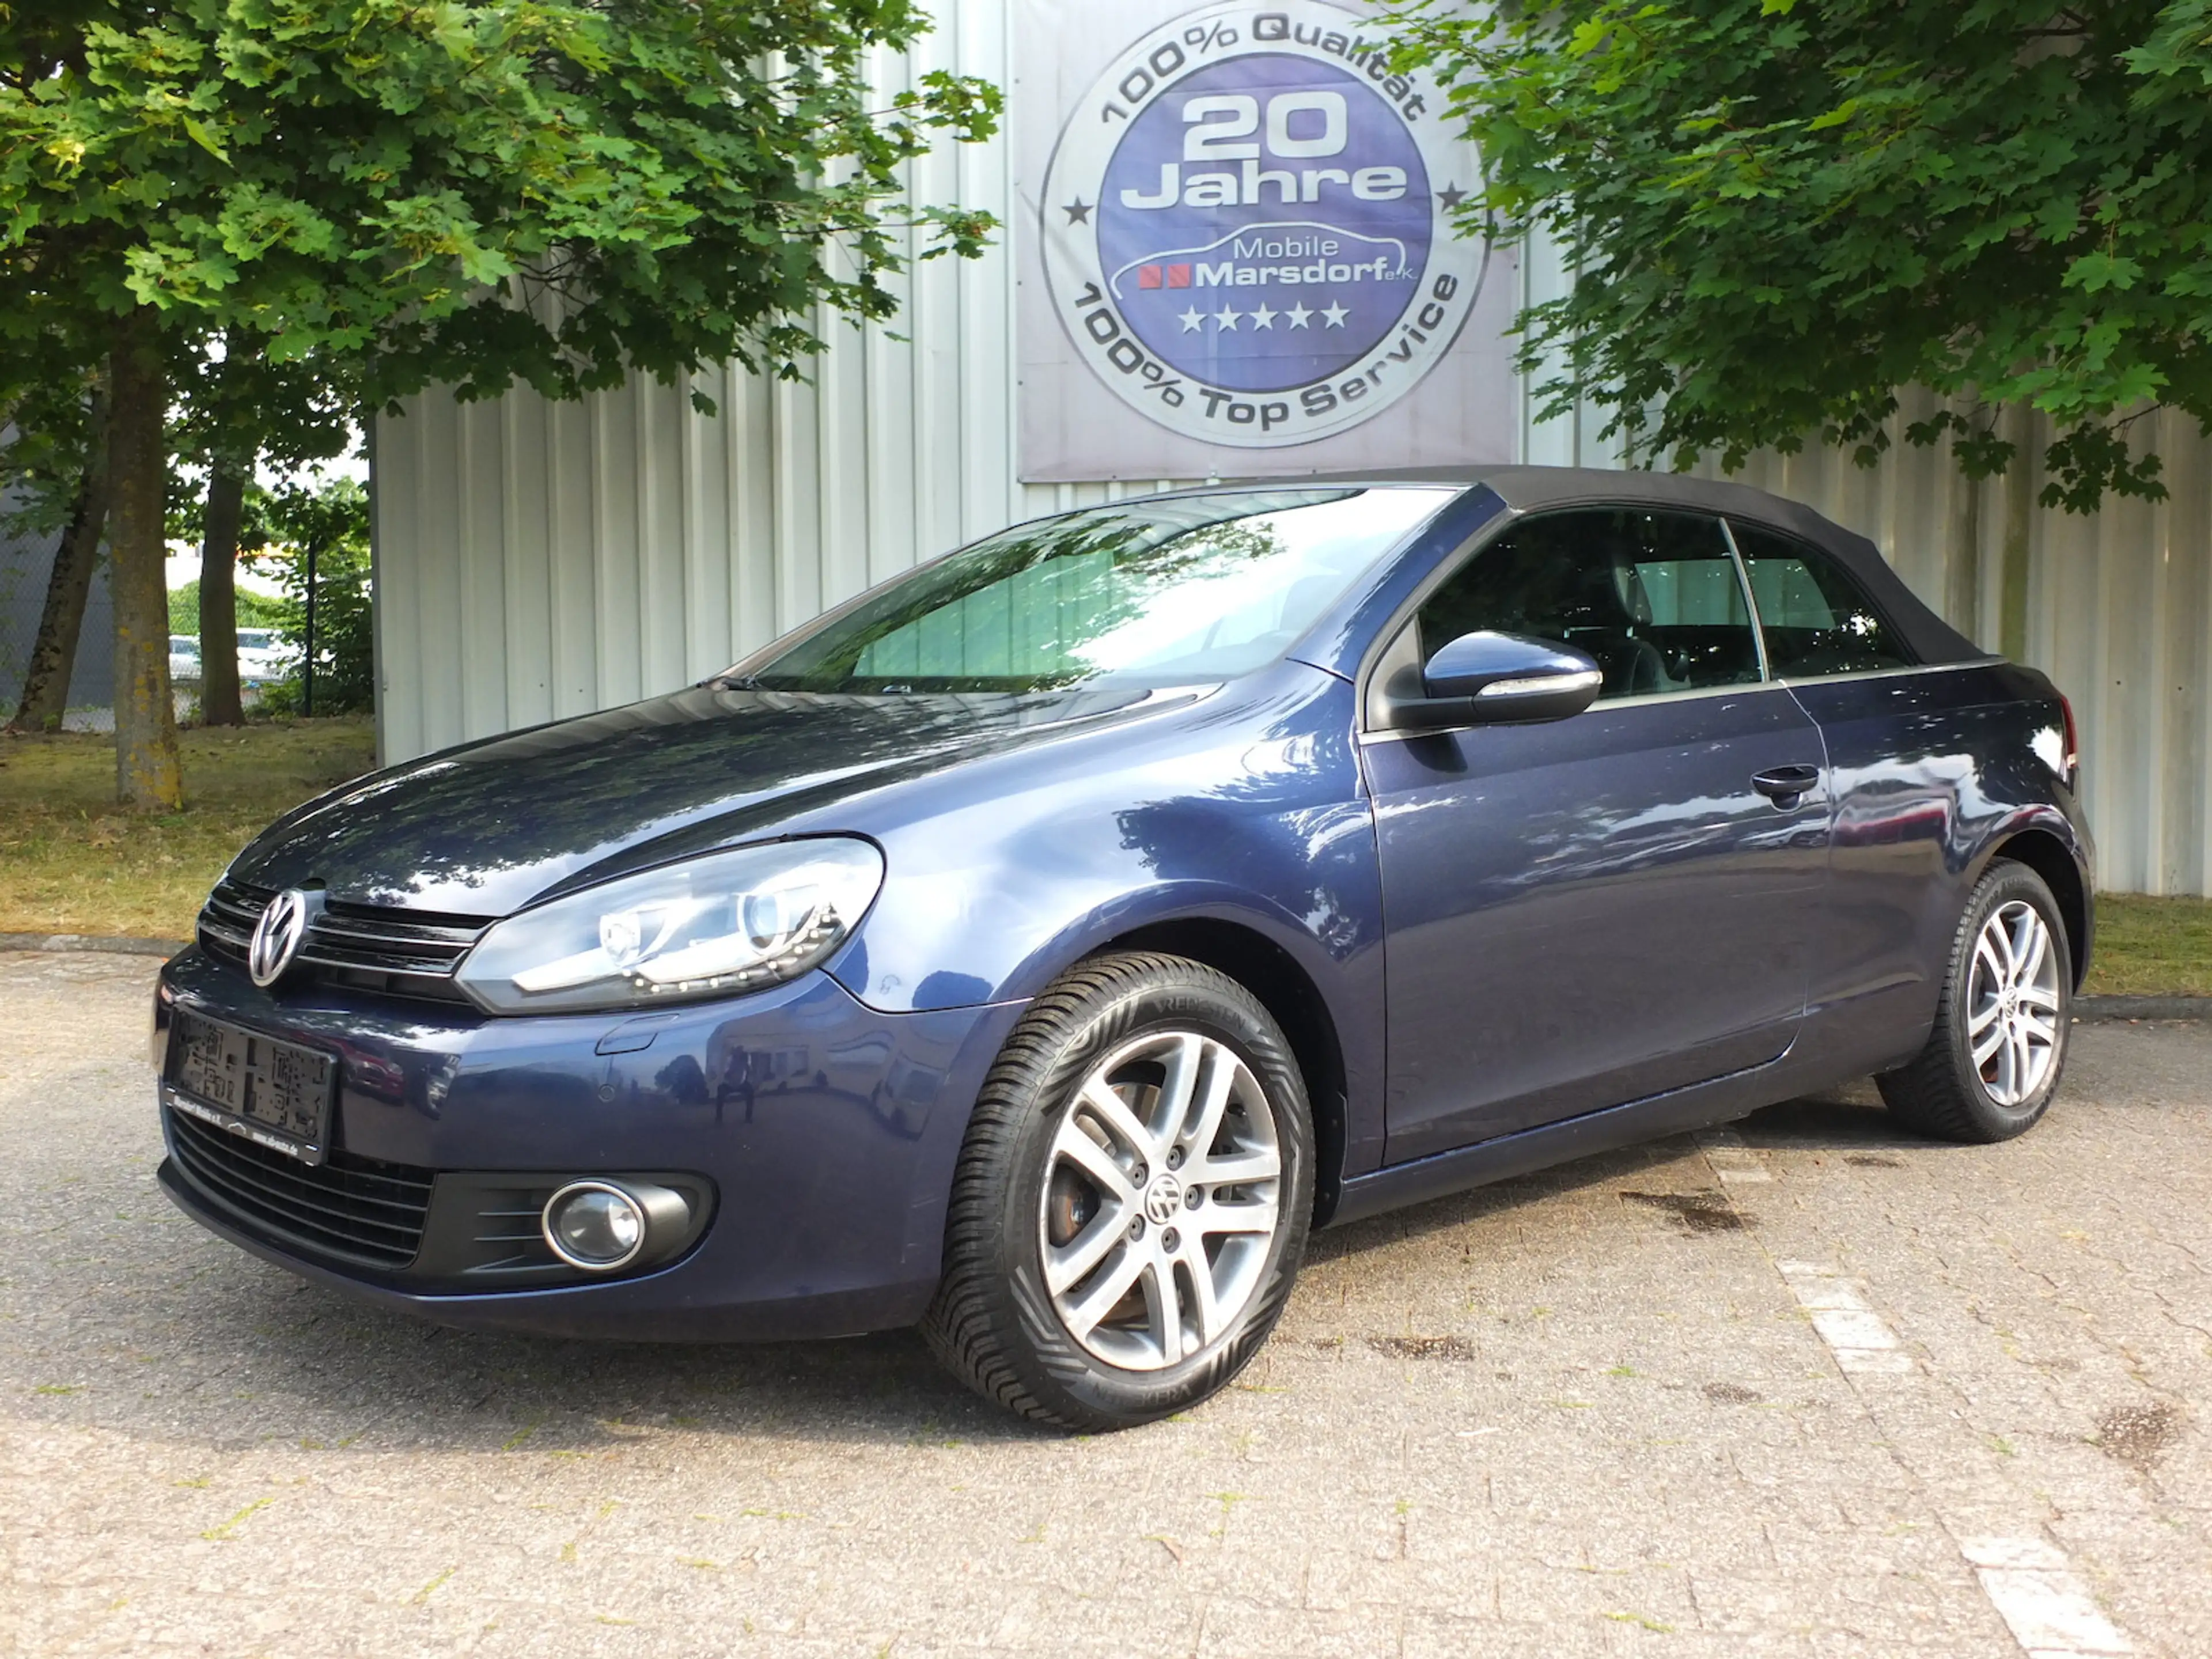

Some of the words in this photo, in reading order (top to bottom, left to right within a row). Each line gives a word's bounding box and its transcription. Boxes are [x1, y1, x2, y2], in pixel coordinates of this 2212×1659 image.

[1101, 20, 1238, 123] 100%
[1252, 12, 1426, 122] Qualität
[1182, 91, 1347, 161] 20
[1120, 160, 1407, 210] Jahre
[1196, 257, 1387, 287] Marsdorf
[1233, 235, 1339, 259] Mobile
[1075, 282, 1184, 408] 100%
[1199, 388, 1289, 431] Top
[1300, 273, 1458, 417] Service
